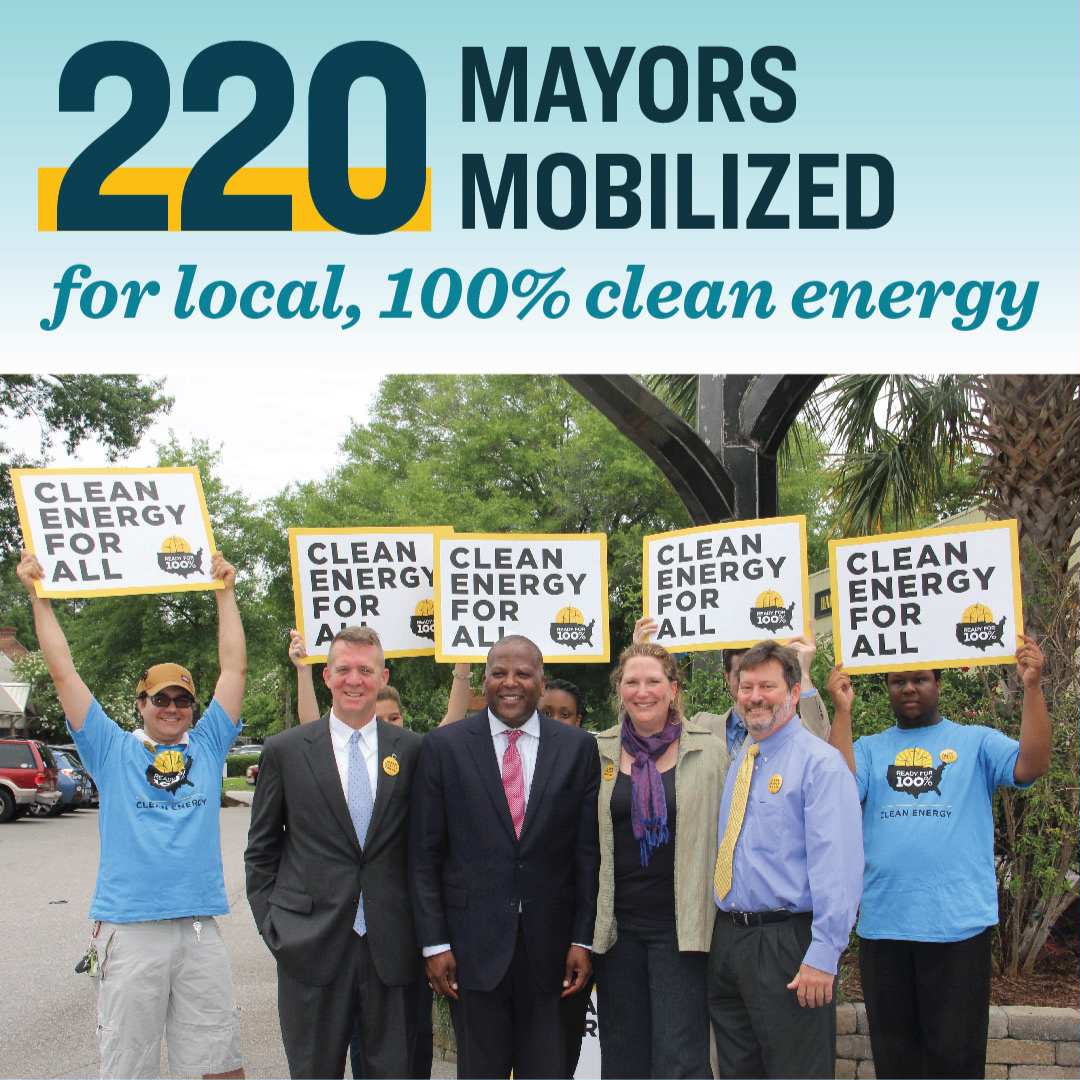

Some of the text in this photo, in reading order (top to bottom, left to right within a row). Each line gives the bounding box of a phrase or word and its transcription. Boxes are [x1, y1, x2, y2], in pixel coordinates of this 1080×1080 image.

[34, 480, 159, 503] CLEAN
[39, 504, 186, 529] ENERGY
[44, 532, 123, 556] FOR
[308, 541, 416, 565] CLEAN
[657, 533, 762, 566] CLEAN
[166, 561, 196, 570] 100%
[450, 547, 562, 569] CLEAN
[847, 540, 968, 575] CLEAN
[51, 558, 122, 583] ALL
[310, 566, 434, 592] ENERGY
[657, 556, 786, 591] ENERGY
[451, 573, 587, 595] ENERGY
[849, 566, 996, 603] ENERGY
[313, 594, 380, 619] FOR
[452, 599, 519, 621] FOR
[658, 588, 719, 615] FOR
[657, 615, 715, 640] ALL
[757, 615, 786, 624] 100%
[850, 603, 922, 630] FOR
[557, 631, 586, 640] 100%
[851, 631, 918, 658] ALL
[964, 630, 996, 642] 100%
[896, 776, 933, 787] 100%
[881, 809, 952, 820] CLEAN ENERGY
